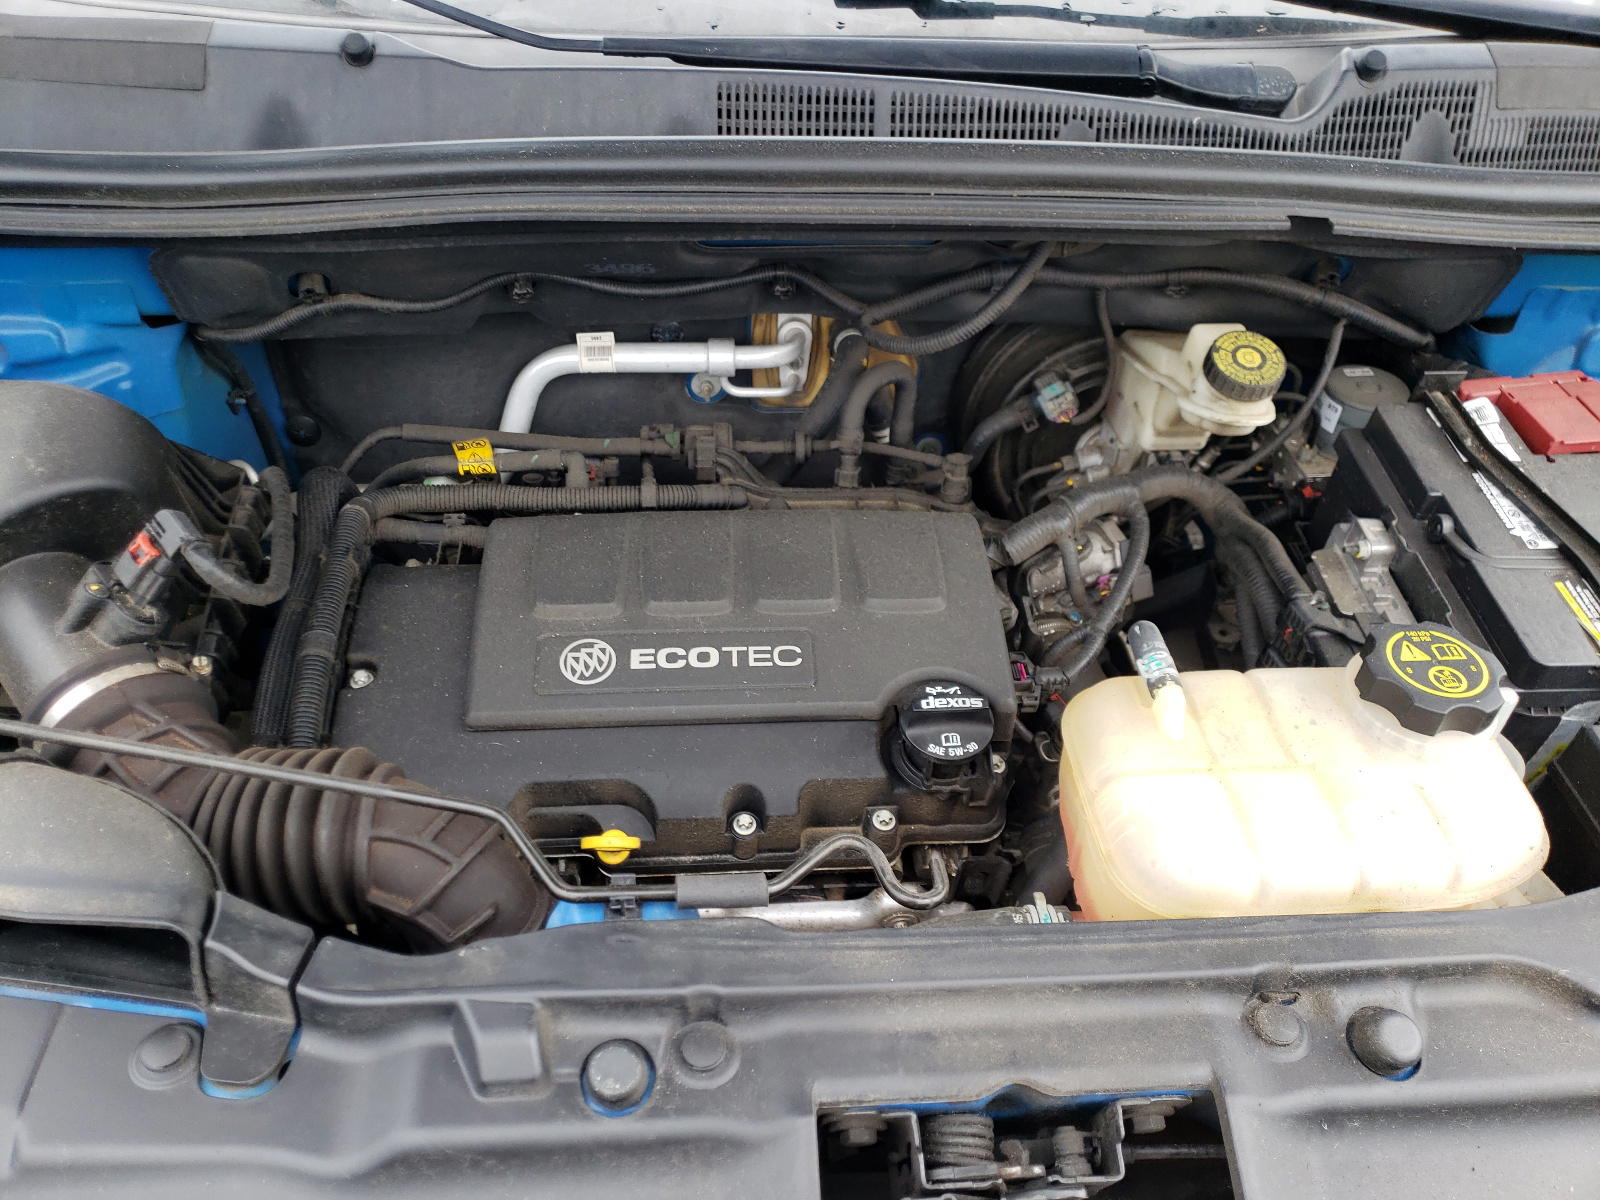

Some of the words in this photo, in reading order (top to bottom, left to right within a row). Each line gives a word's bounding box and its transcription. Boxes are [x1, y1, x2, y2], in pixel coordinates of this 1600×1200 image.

[630, 645, 803, 669] ECOTEC
[920, 696, 984, 709] dexos
[927, 743, 946, 756] SAE
[948, 741, 979, 756] 5W-30
